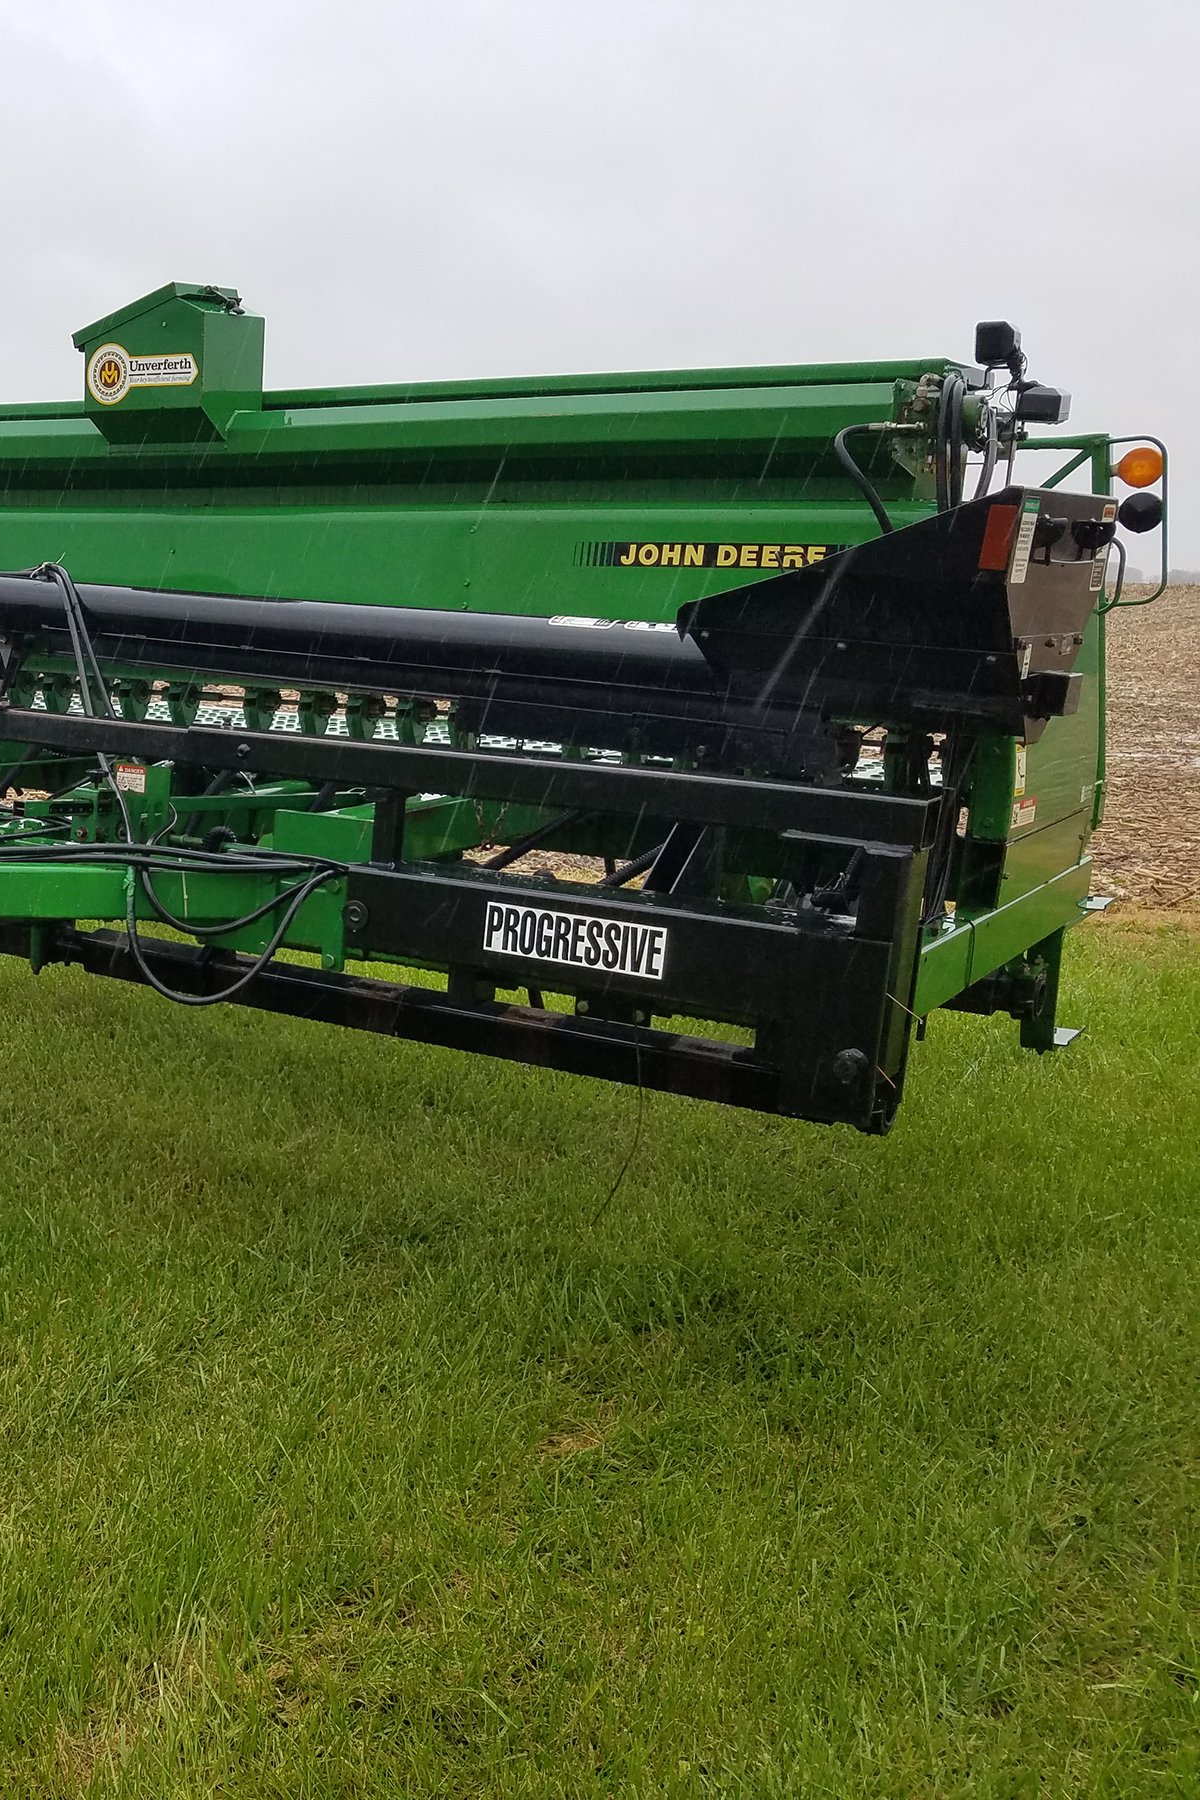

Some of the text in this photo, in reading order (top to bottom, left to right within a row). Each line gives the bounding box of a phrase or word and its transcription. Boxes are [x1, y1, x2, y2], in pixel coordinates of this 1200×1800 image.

[129, 358, 191, 372] Unverferth
[620, 543, 705, 566] JOHN
[485, 905, 664, 976] PROGRESSIVE
